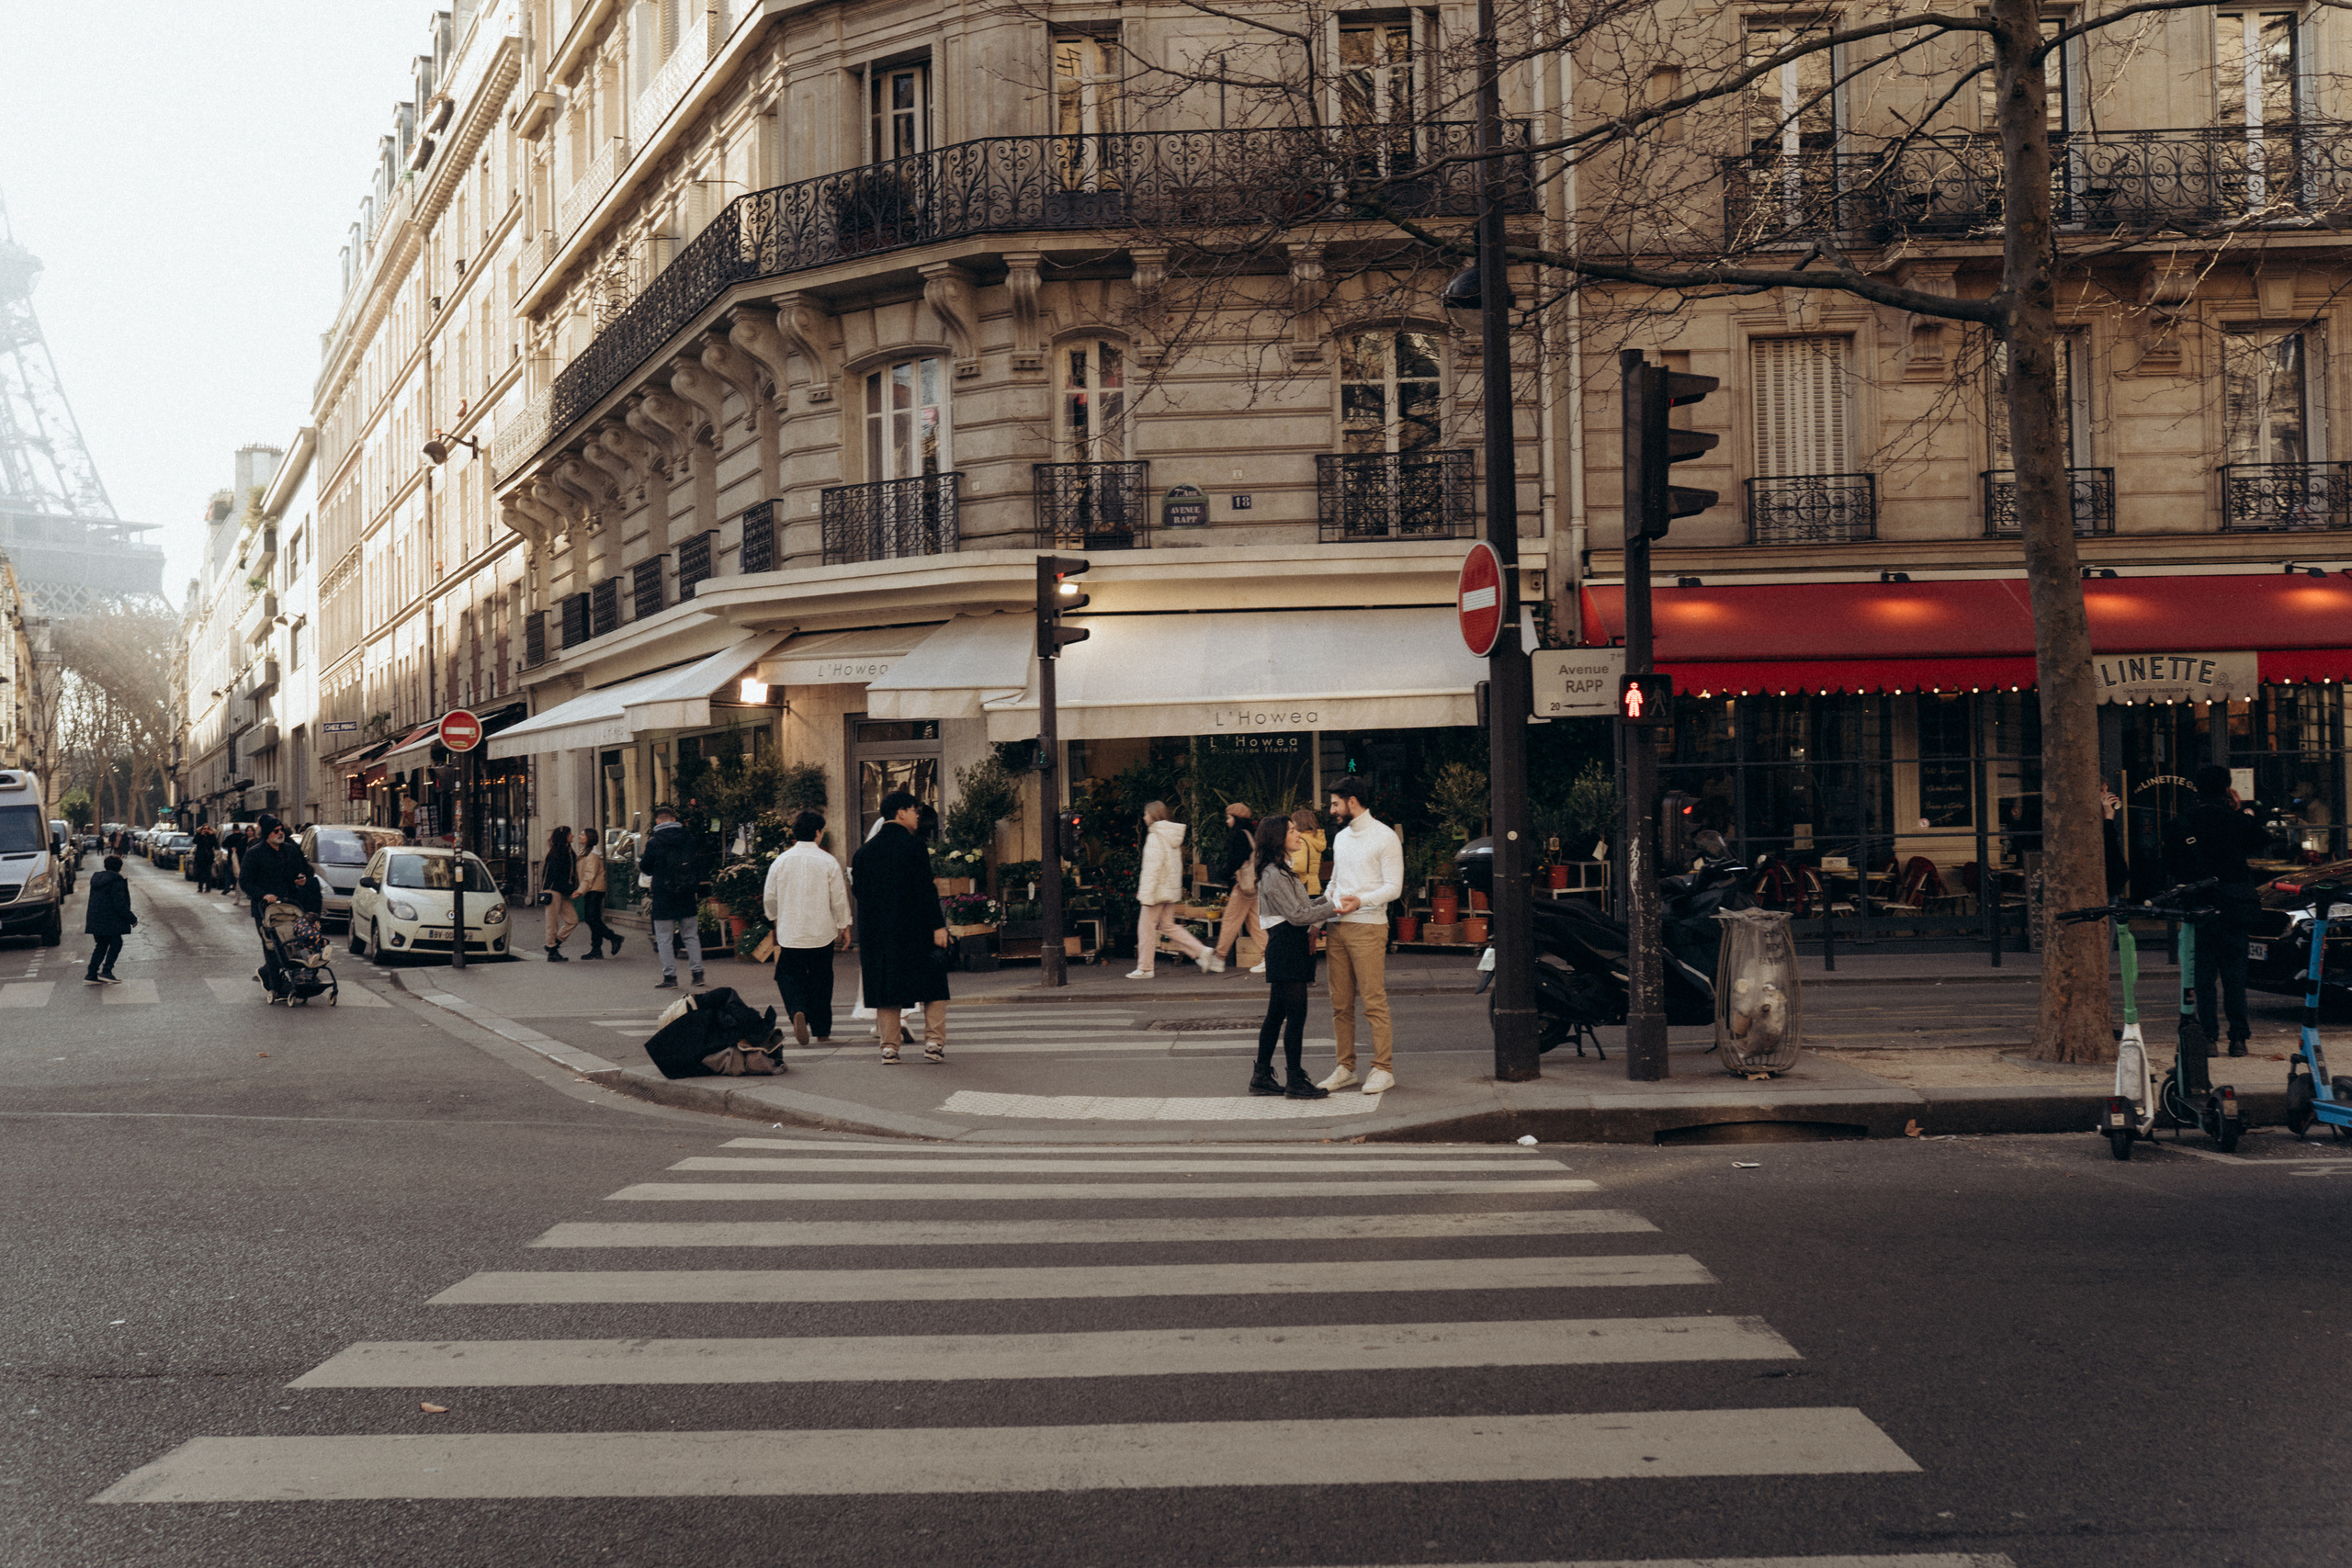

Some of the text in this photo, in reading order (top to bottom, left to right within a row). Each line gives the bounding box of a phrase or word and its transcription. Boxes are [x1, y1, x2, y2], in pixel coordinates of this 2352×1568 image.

[1235, 497, 1250, 508] 18
[1170, 506, 1201, 514] AVENUE
[1173, 515, 1198, 524] RAPP
[818, 663, 888, 677] L'Howea
[1558, 664, 1610, 675] Avenue
[2100, 656, 2216, 687] LINETTE
[1566, 679, 1604, 694] RAPP
[1550, 702, 1561, 711] 20
[1216, 711, 1318, 727] L'Howea
[324, 724, 341, 732] CHEZ
[2140, 775, 2187, 789] LINETTE
